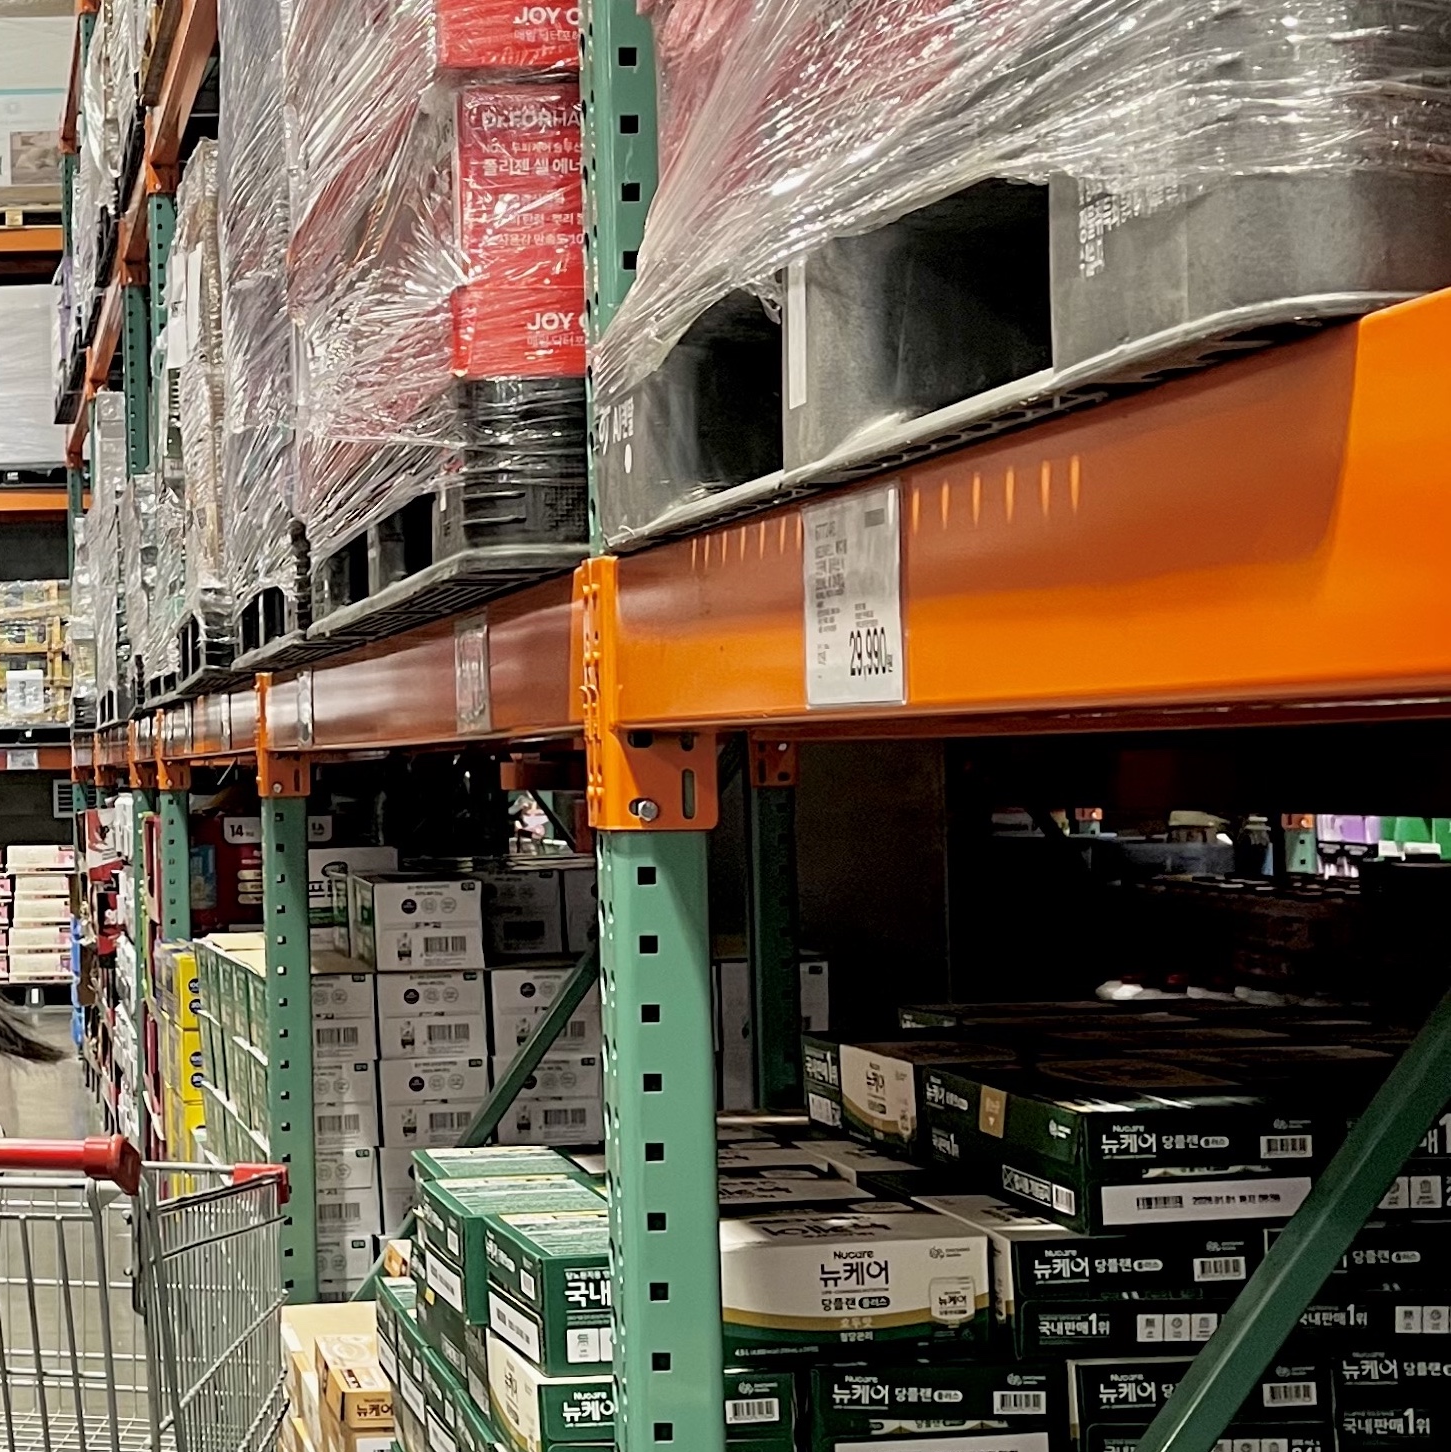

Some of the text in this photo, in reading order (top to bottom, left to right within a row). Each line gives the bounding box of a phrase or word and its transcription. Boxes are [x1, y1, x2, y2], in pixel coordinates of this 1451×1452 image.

[1101, 1133, 1157, 1154] 뉴케어
[833, 1250, 875, 1261] Nucare
[819, 1260, 890, 1288] 뉴케어
[1033, 1257, 1090, 1279] 뉴케어
[1342, 1359, 1398, 1380] 뉴케어
[832, 1384, 889, 1405] 뉴케어
[1099, 1381, 1157, 1404] 뉴케어
